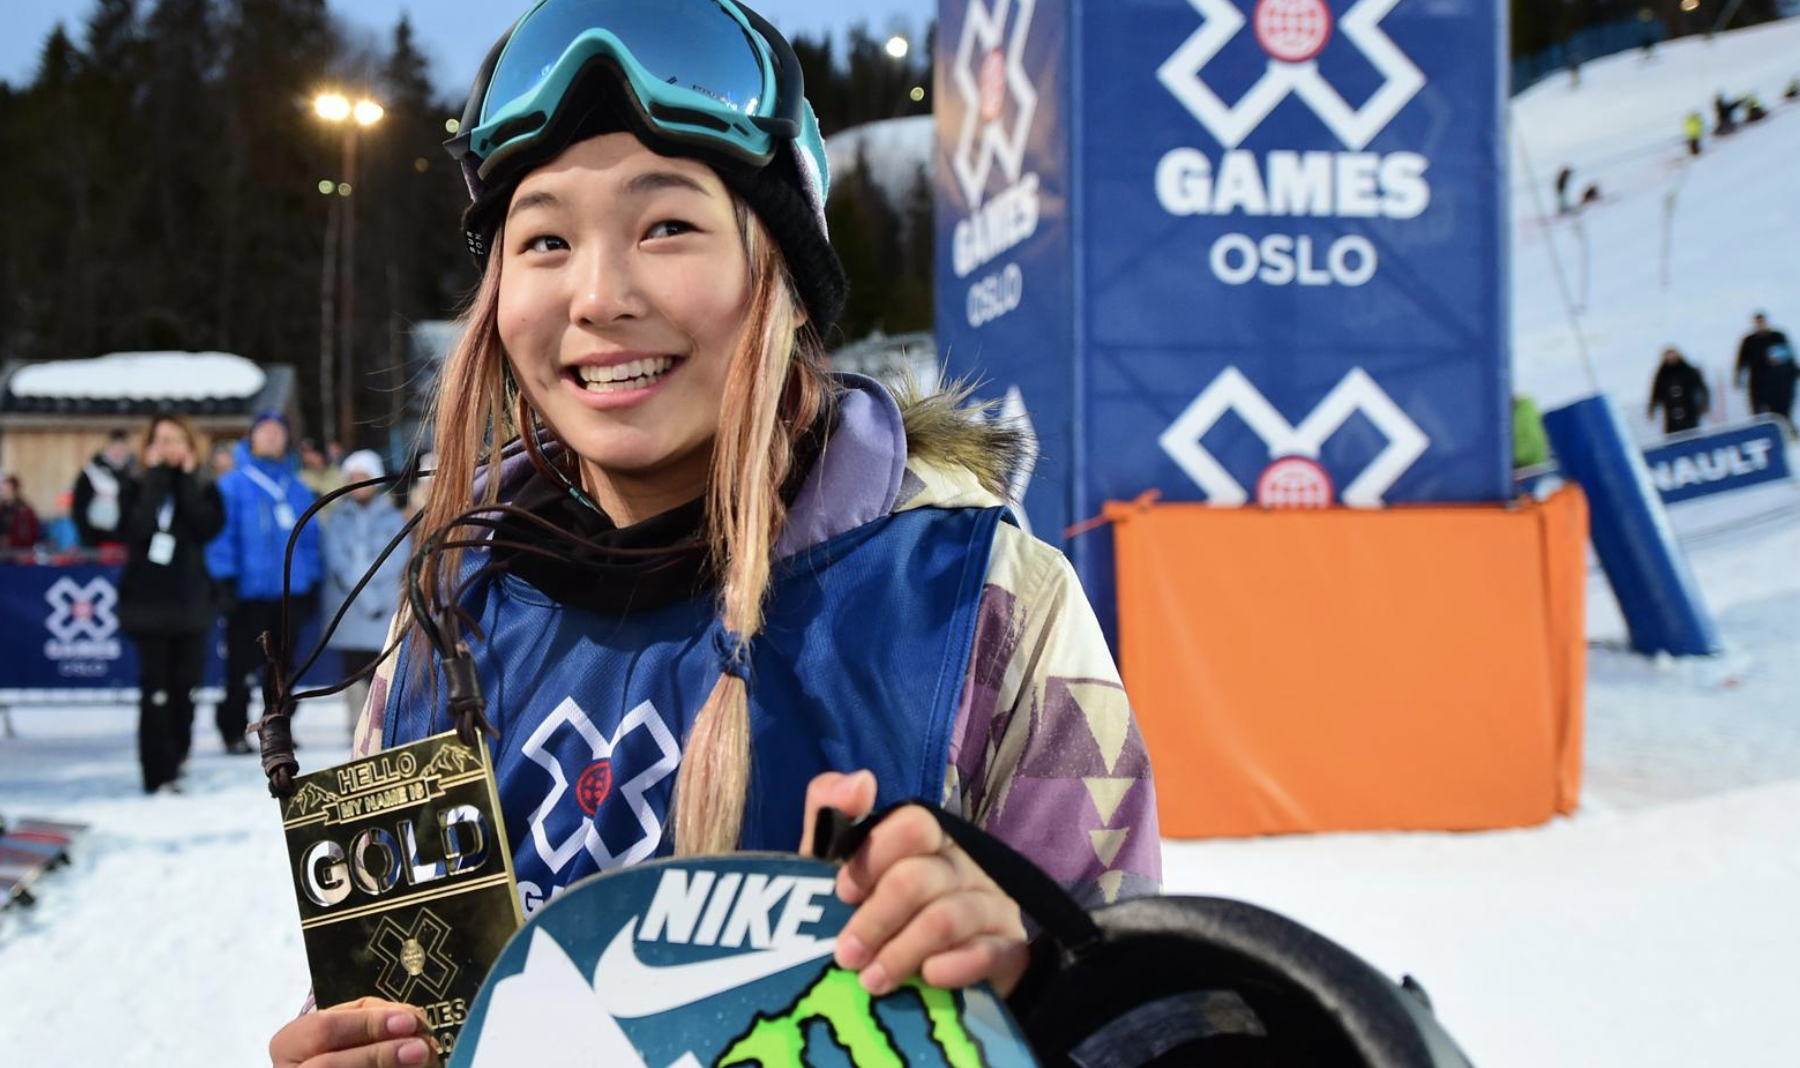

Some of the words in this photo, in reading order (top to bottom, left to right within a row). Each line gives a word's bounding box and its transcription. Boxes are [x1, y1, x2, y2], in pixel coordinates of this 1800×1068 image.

[1154, 147, 1431, 219] GAMES
[953, 171, 1040, 278] GAMES
[1209, 233, 1378, 287] OSLO
[1652, 437, 1772, 491] NAULT
[337, 751, 417, 795] HELLO
[341, 798, 362, 819] MY
[364, 786, 408, 813] NAME
[409, 782, 425, 801] IS
[300, 805, 490, 907] GOLD
[638, 868, 836, 951] NIKE
